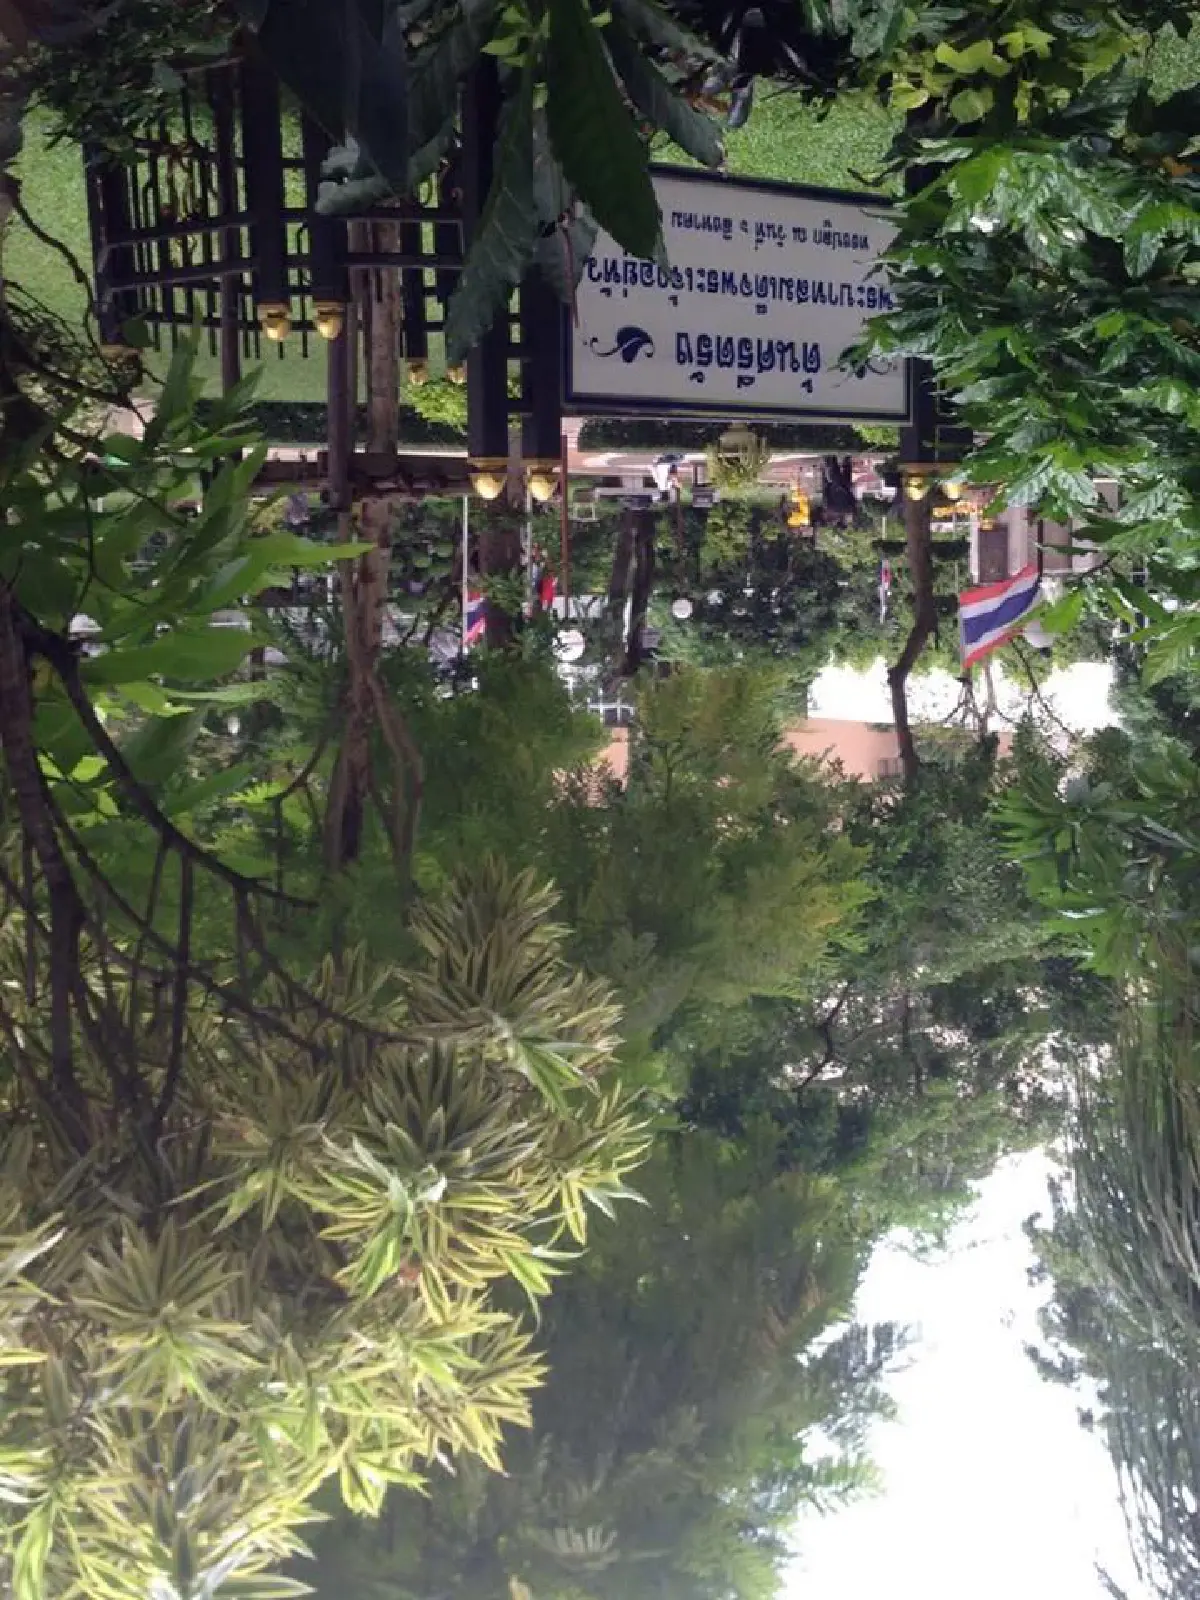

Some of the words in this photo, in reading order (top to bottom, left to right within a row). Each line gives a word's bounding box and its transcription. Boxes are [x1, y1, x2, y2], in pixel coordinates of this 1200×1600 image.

[673, 213, 732, 240] สิงหาคม
[756, 224, 786, 250] วันที่
[793, 228, 807, 243] ณ
[814, 221, 869, 250] ทรงปลูก
[677, 334, 820, 392] ต้นศรีตรัง
